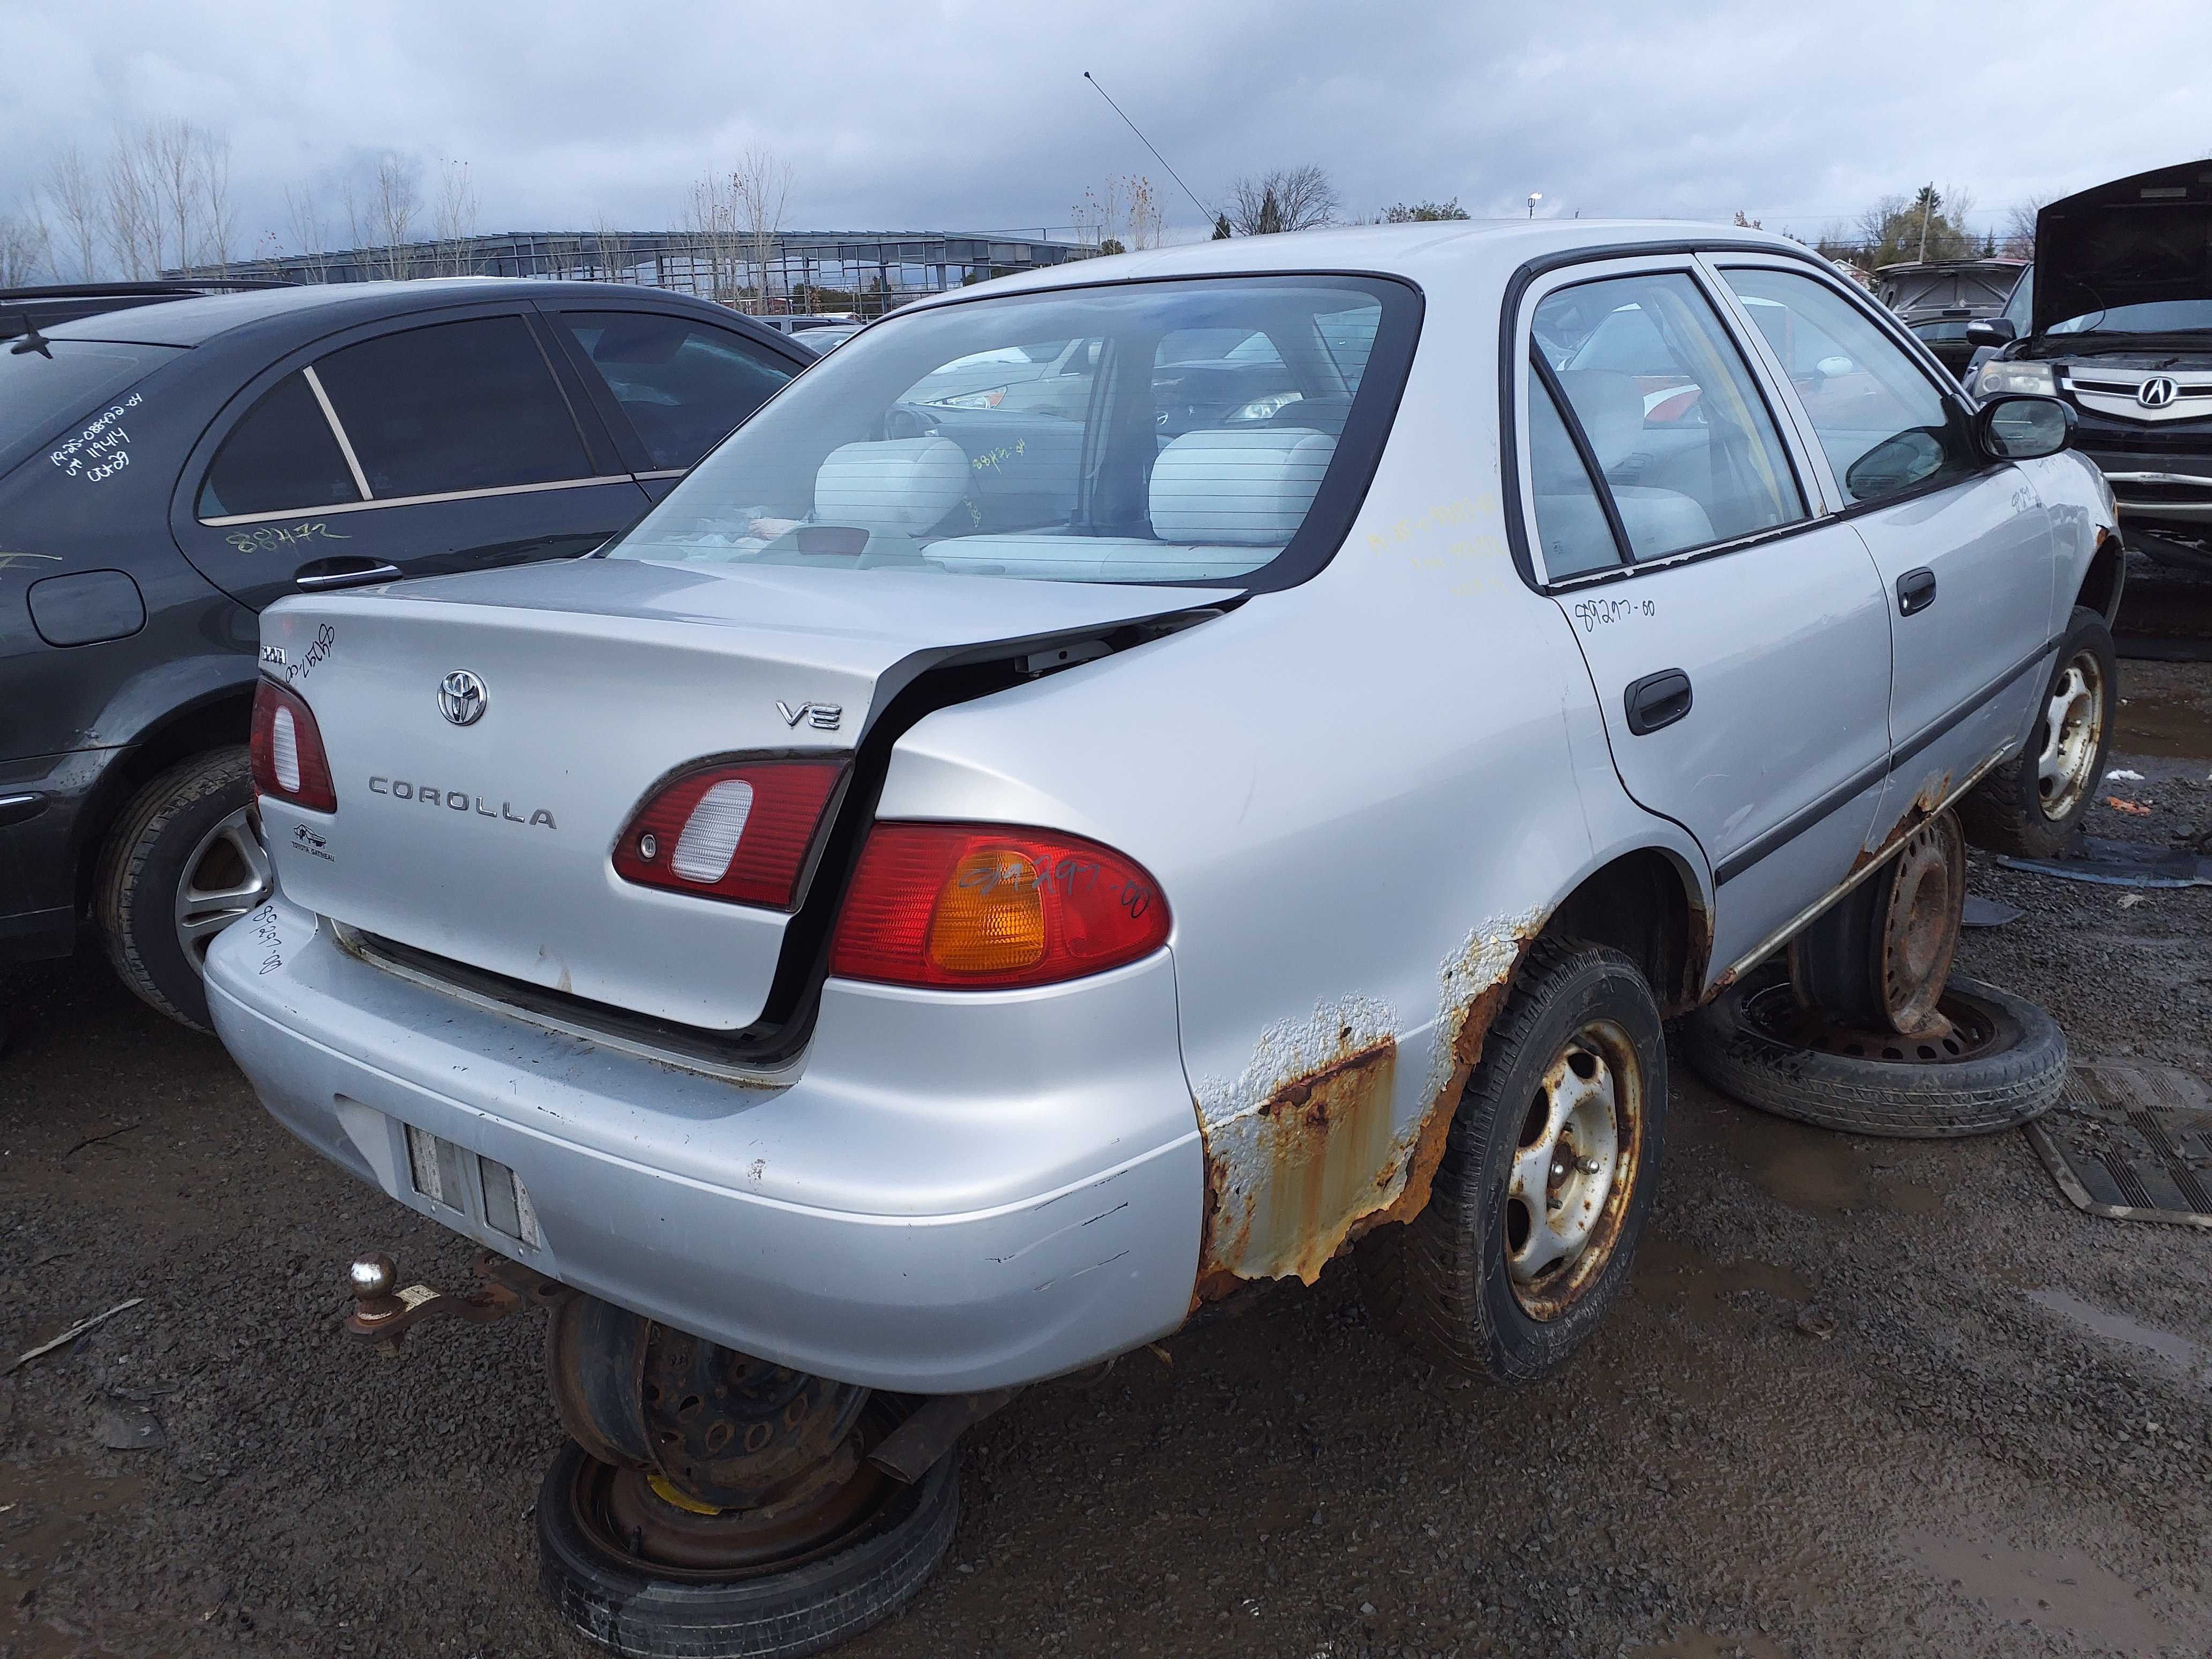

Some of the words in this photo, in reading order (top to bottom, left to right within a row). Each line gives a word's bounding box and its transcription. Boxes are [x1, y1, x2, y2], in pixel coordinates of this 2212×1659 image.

[369, 776, 557, 829] COROLLA
[291, 841, 310, 853] TOYOTA
[311, 848, 335, 862] GATINEAU
